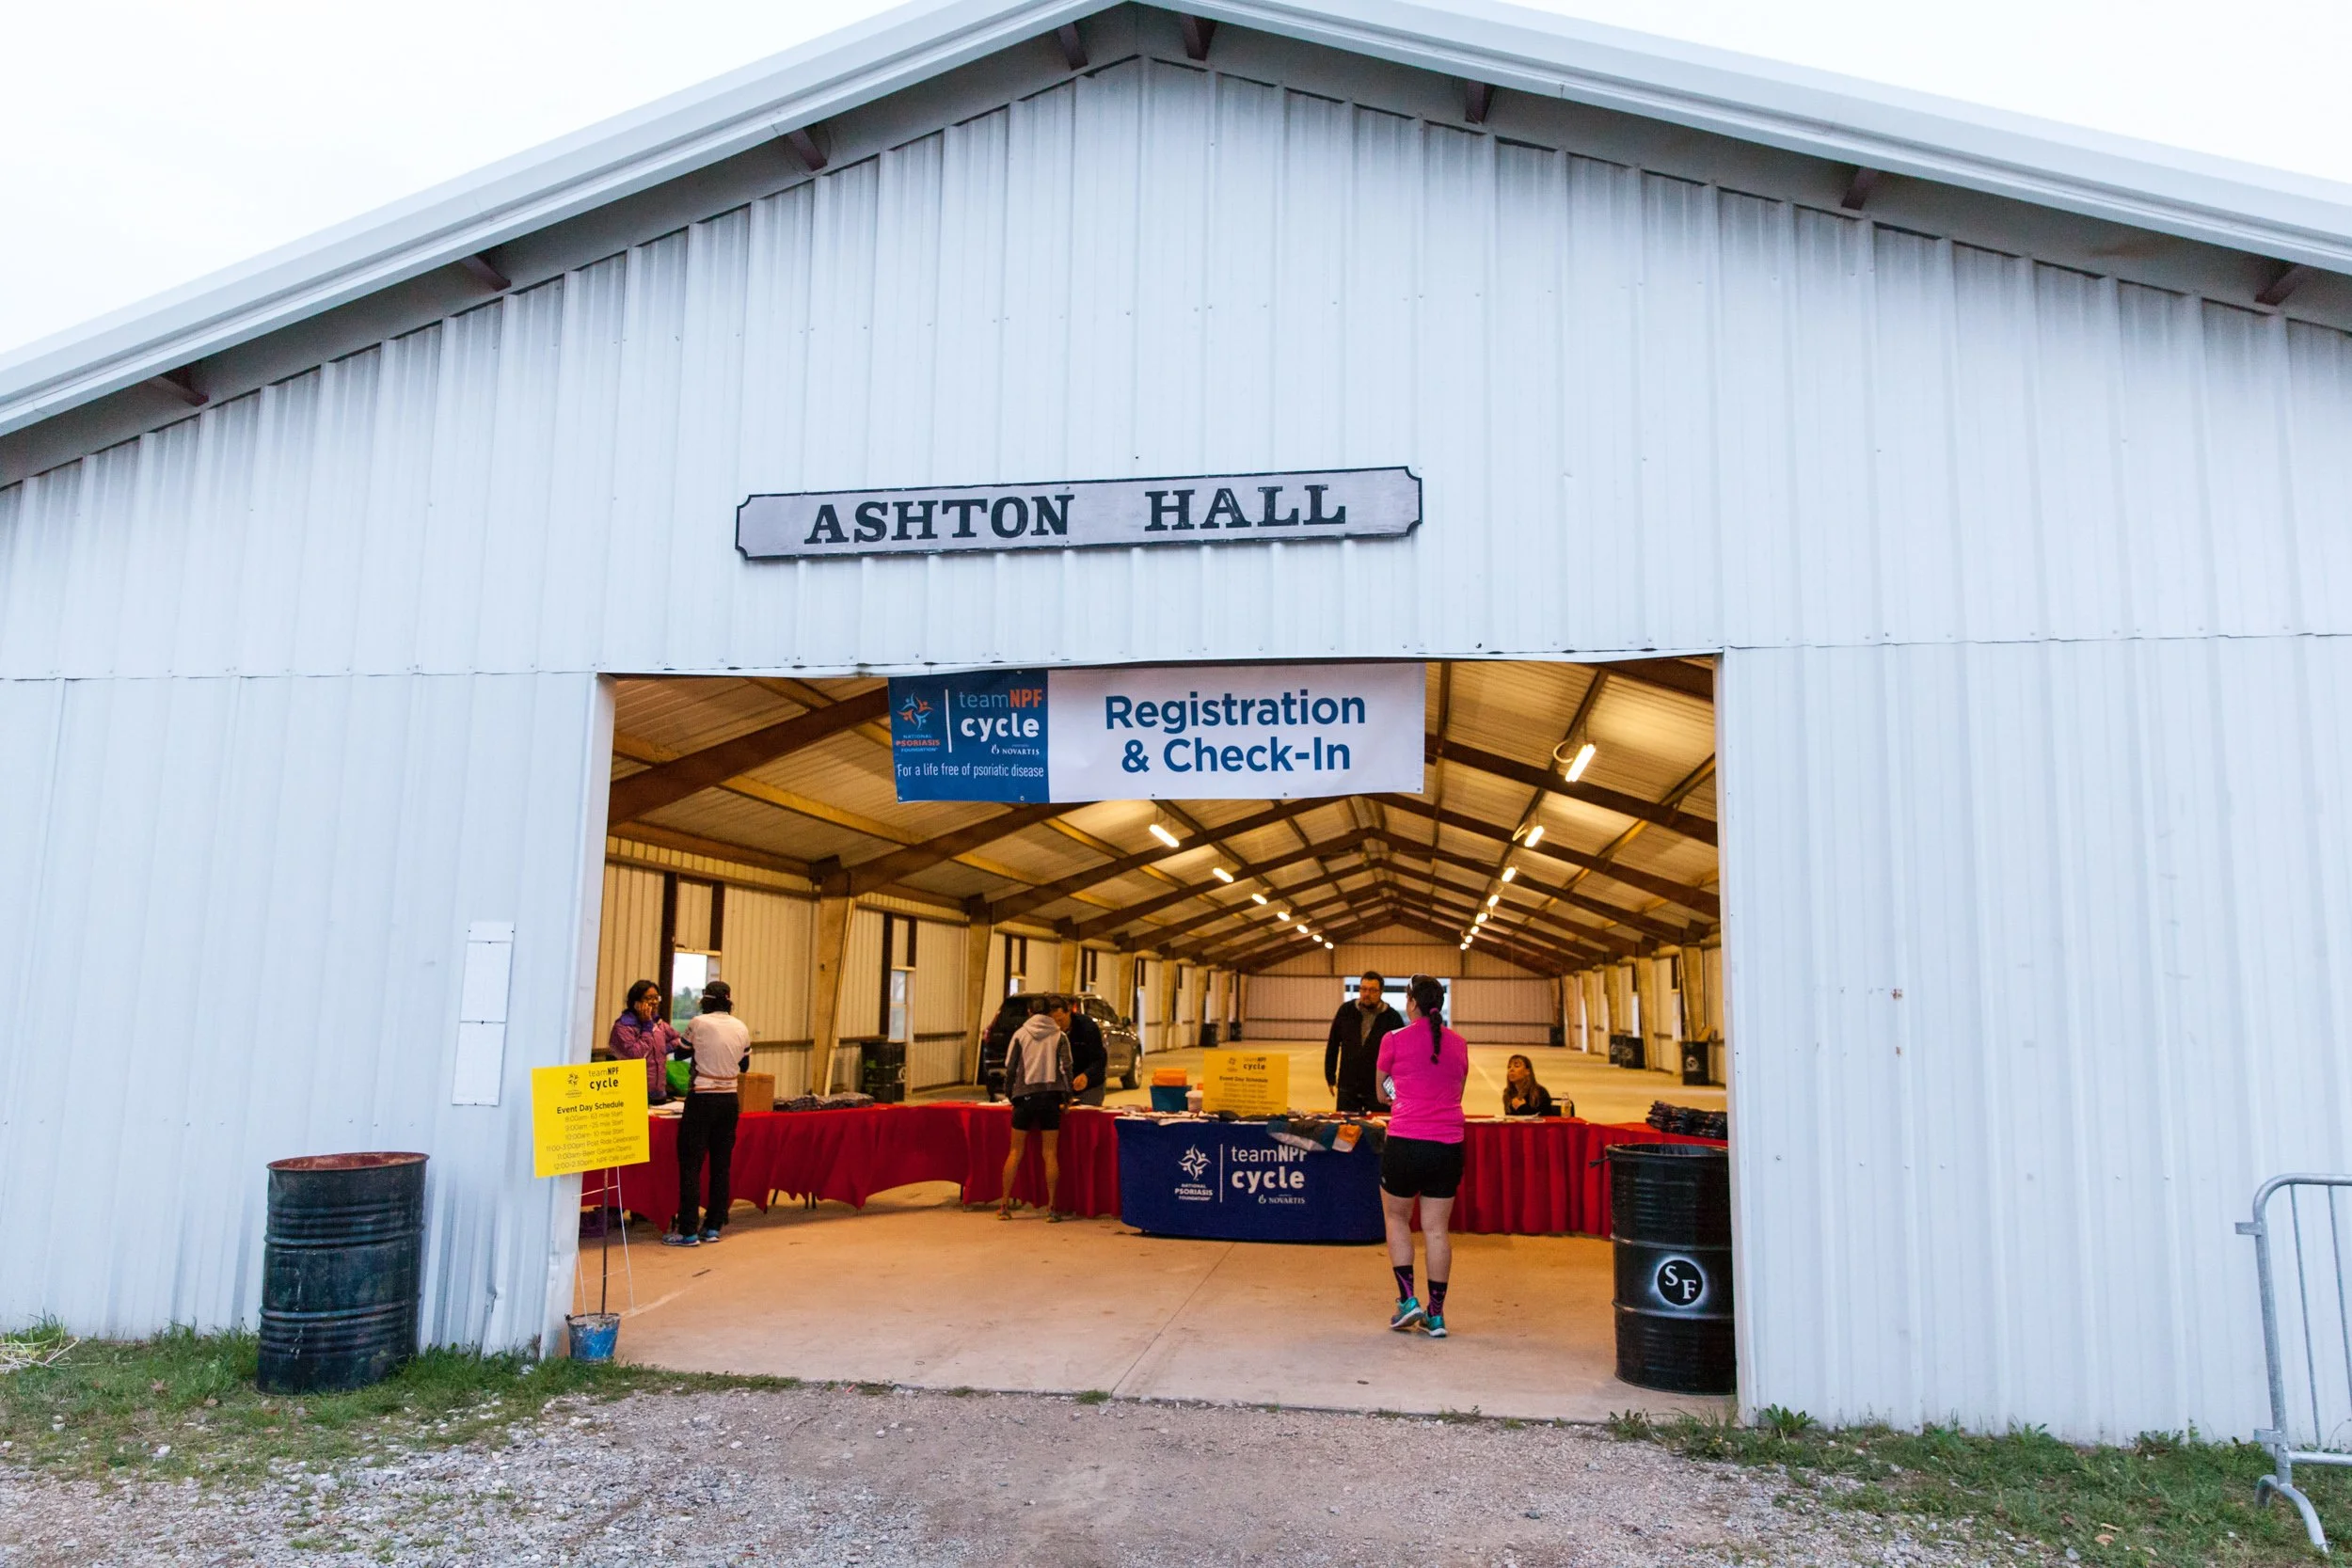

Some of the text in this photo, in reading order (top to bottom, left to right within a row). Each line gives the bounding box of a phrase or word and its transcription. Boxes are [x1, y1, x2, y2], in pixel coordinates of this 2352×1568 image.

[803, 484, 1346, 545] ASHTON HALL
[959, 689, 1042, 708] teamNPF
[1105, 689, 1365, 734] Registration
[961, 712, 1040, 742] cycle
[1002, 748, 1040, 756] NOVARTIS
[1121, 736, 1350, 772] & Check-In
[898, 763, 1044, 779] For a life free of psoriatic disease
[589, 1067, 619, 1077] teamNPF
[590, 1077, 619, 1091] cycle
[557, 1105, 578, 1114] Event
[595, 1101, 624, 1110] Schedule
[1232, 1165, 1305, 1194] cycle
